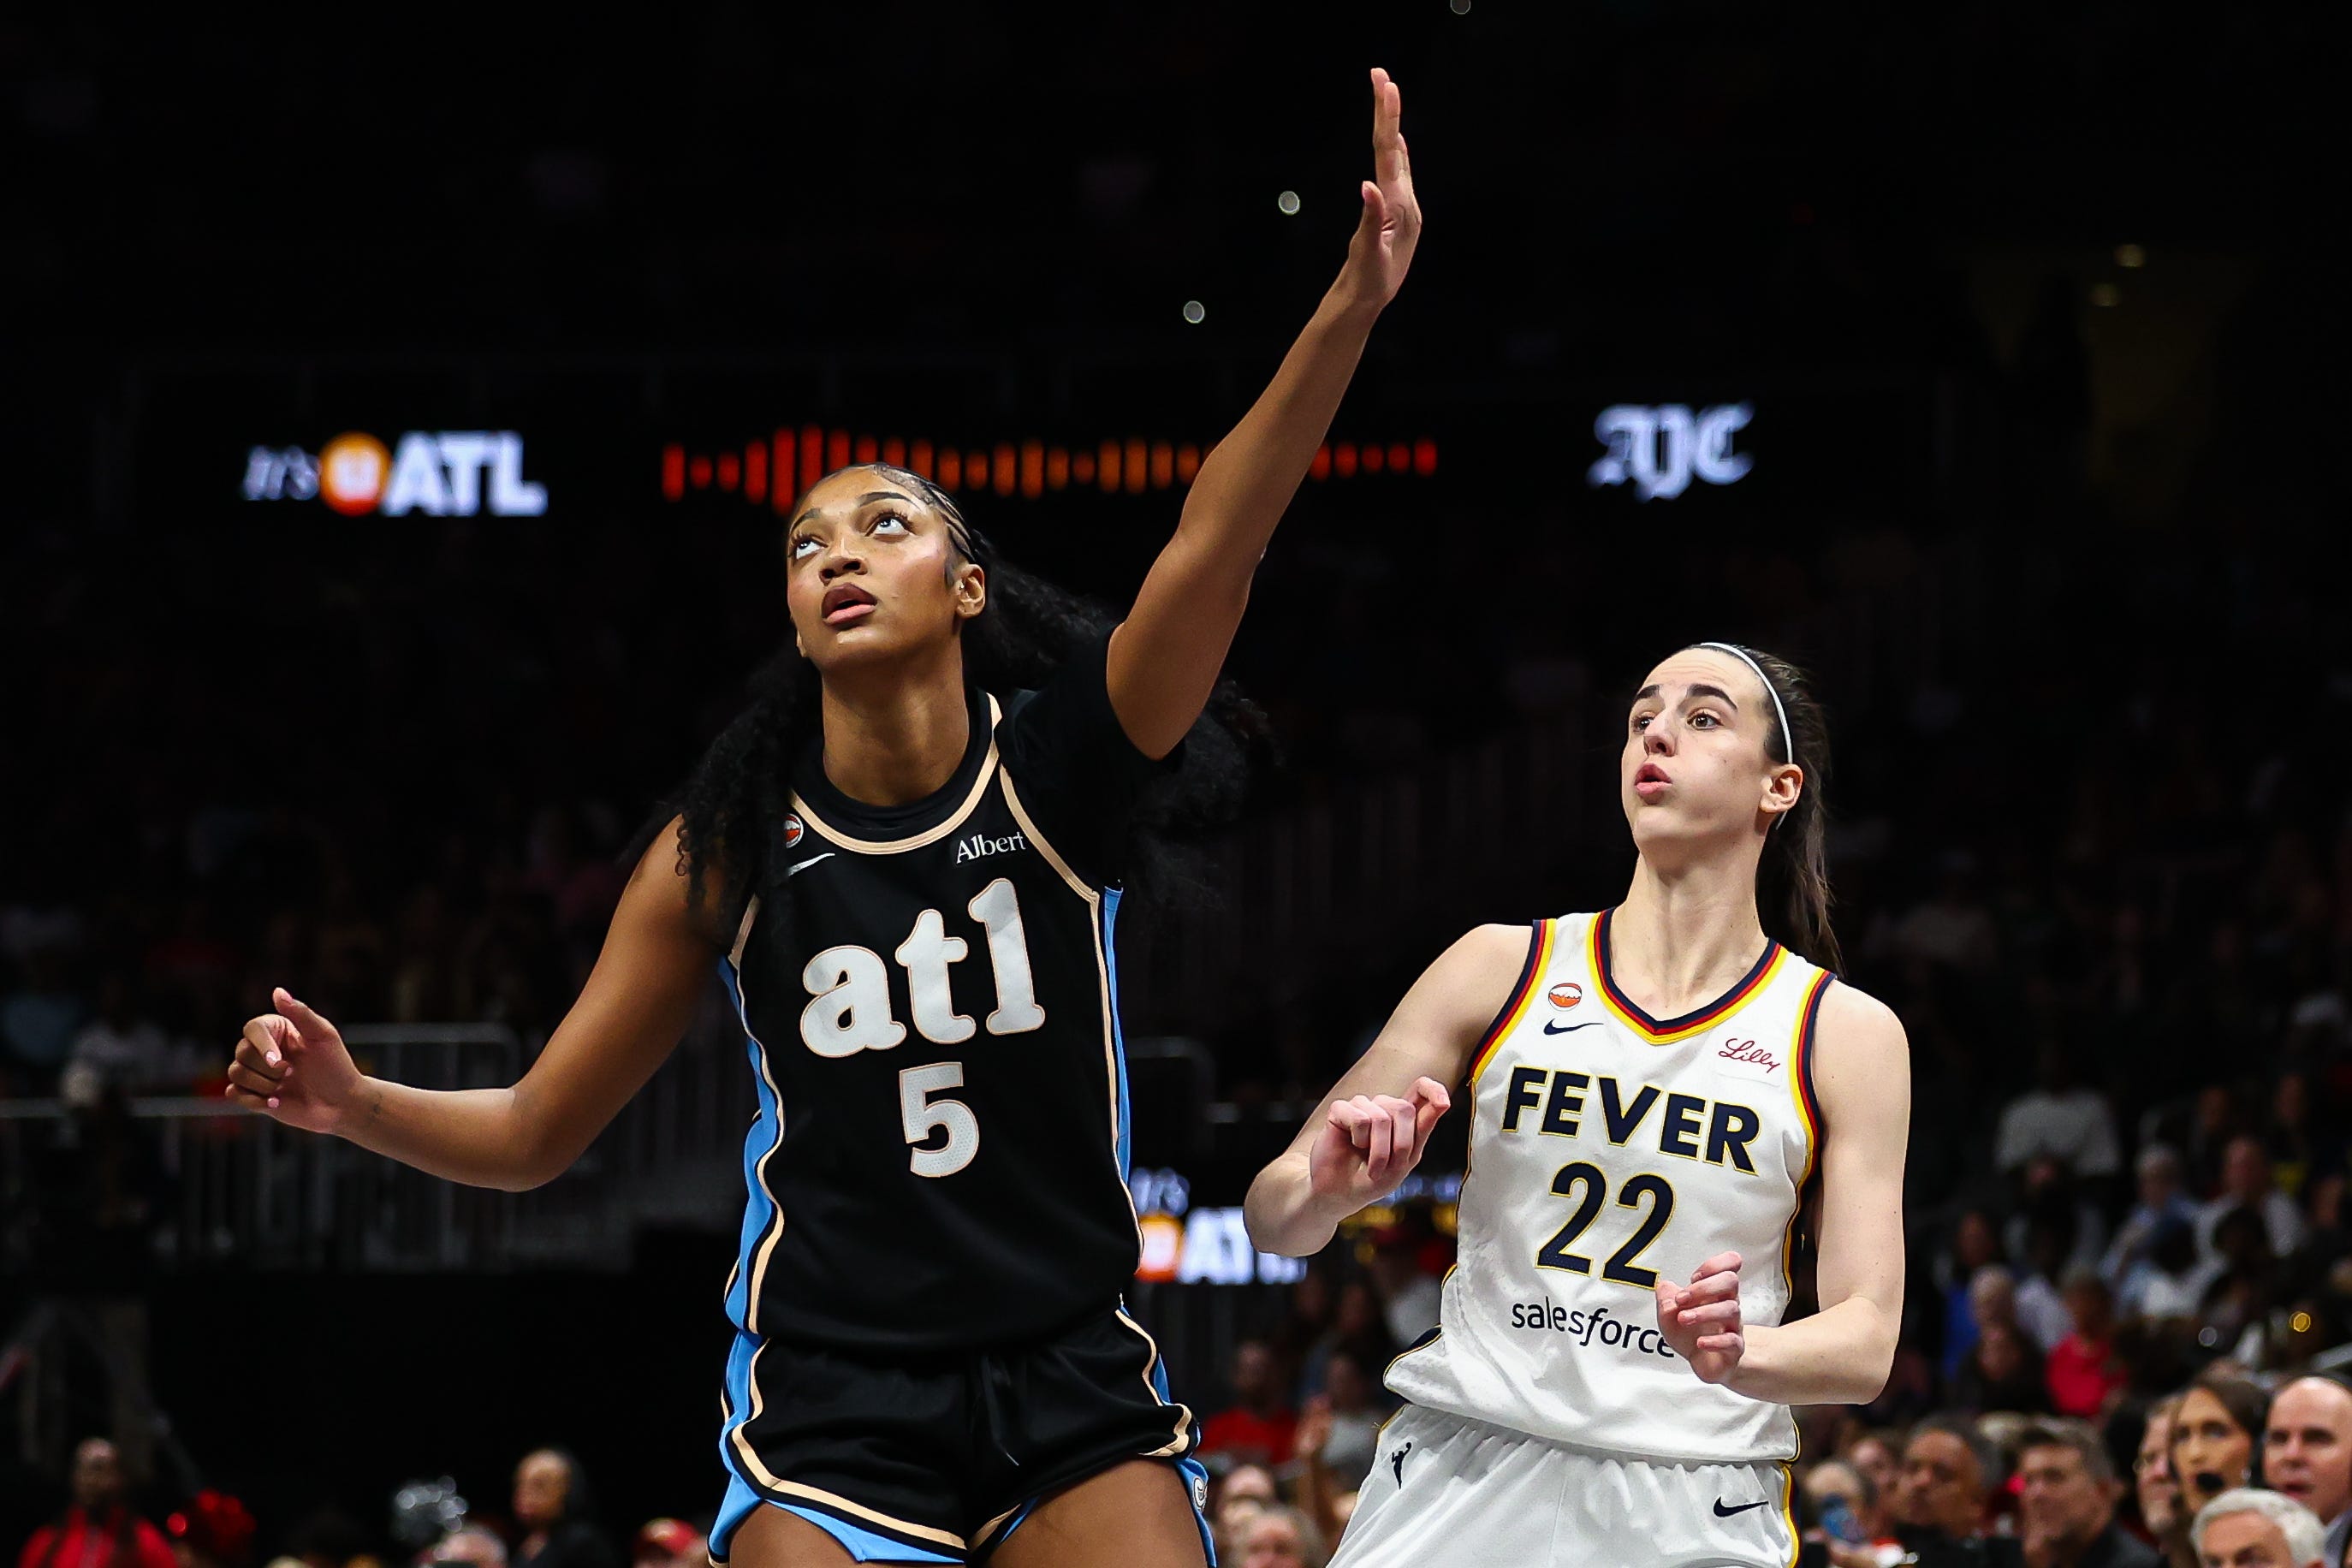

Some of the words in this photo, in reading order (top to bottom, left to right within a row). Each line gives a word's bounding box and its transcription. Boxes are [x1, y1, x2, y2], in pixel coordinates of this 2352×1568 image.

[956, 831, 1026, 864] Albert
[799, 877, 1046, 1058] atl
[1718, 1037, 1781, 1074] Lilly
[899, 1061, 980, 1178] 5
[1501, 1065, 1761, 1176] FEVER
[1534, 1160, 1677, 1291] 22
